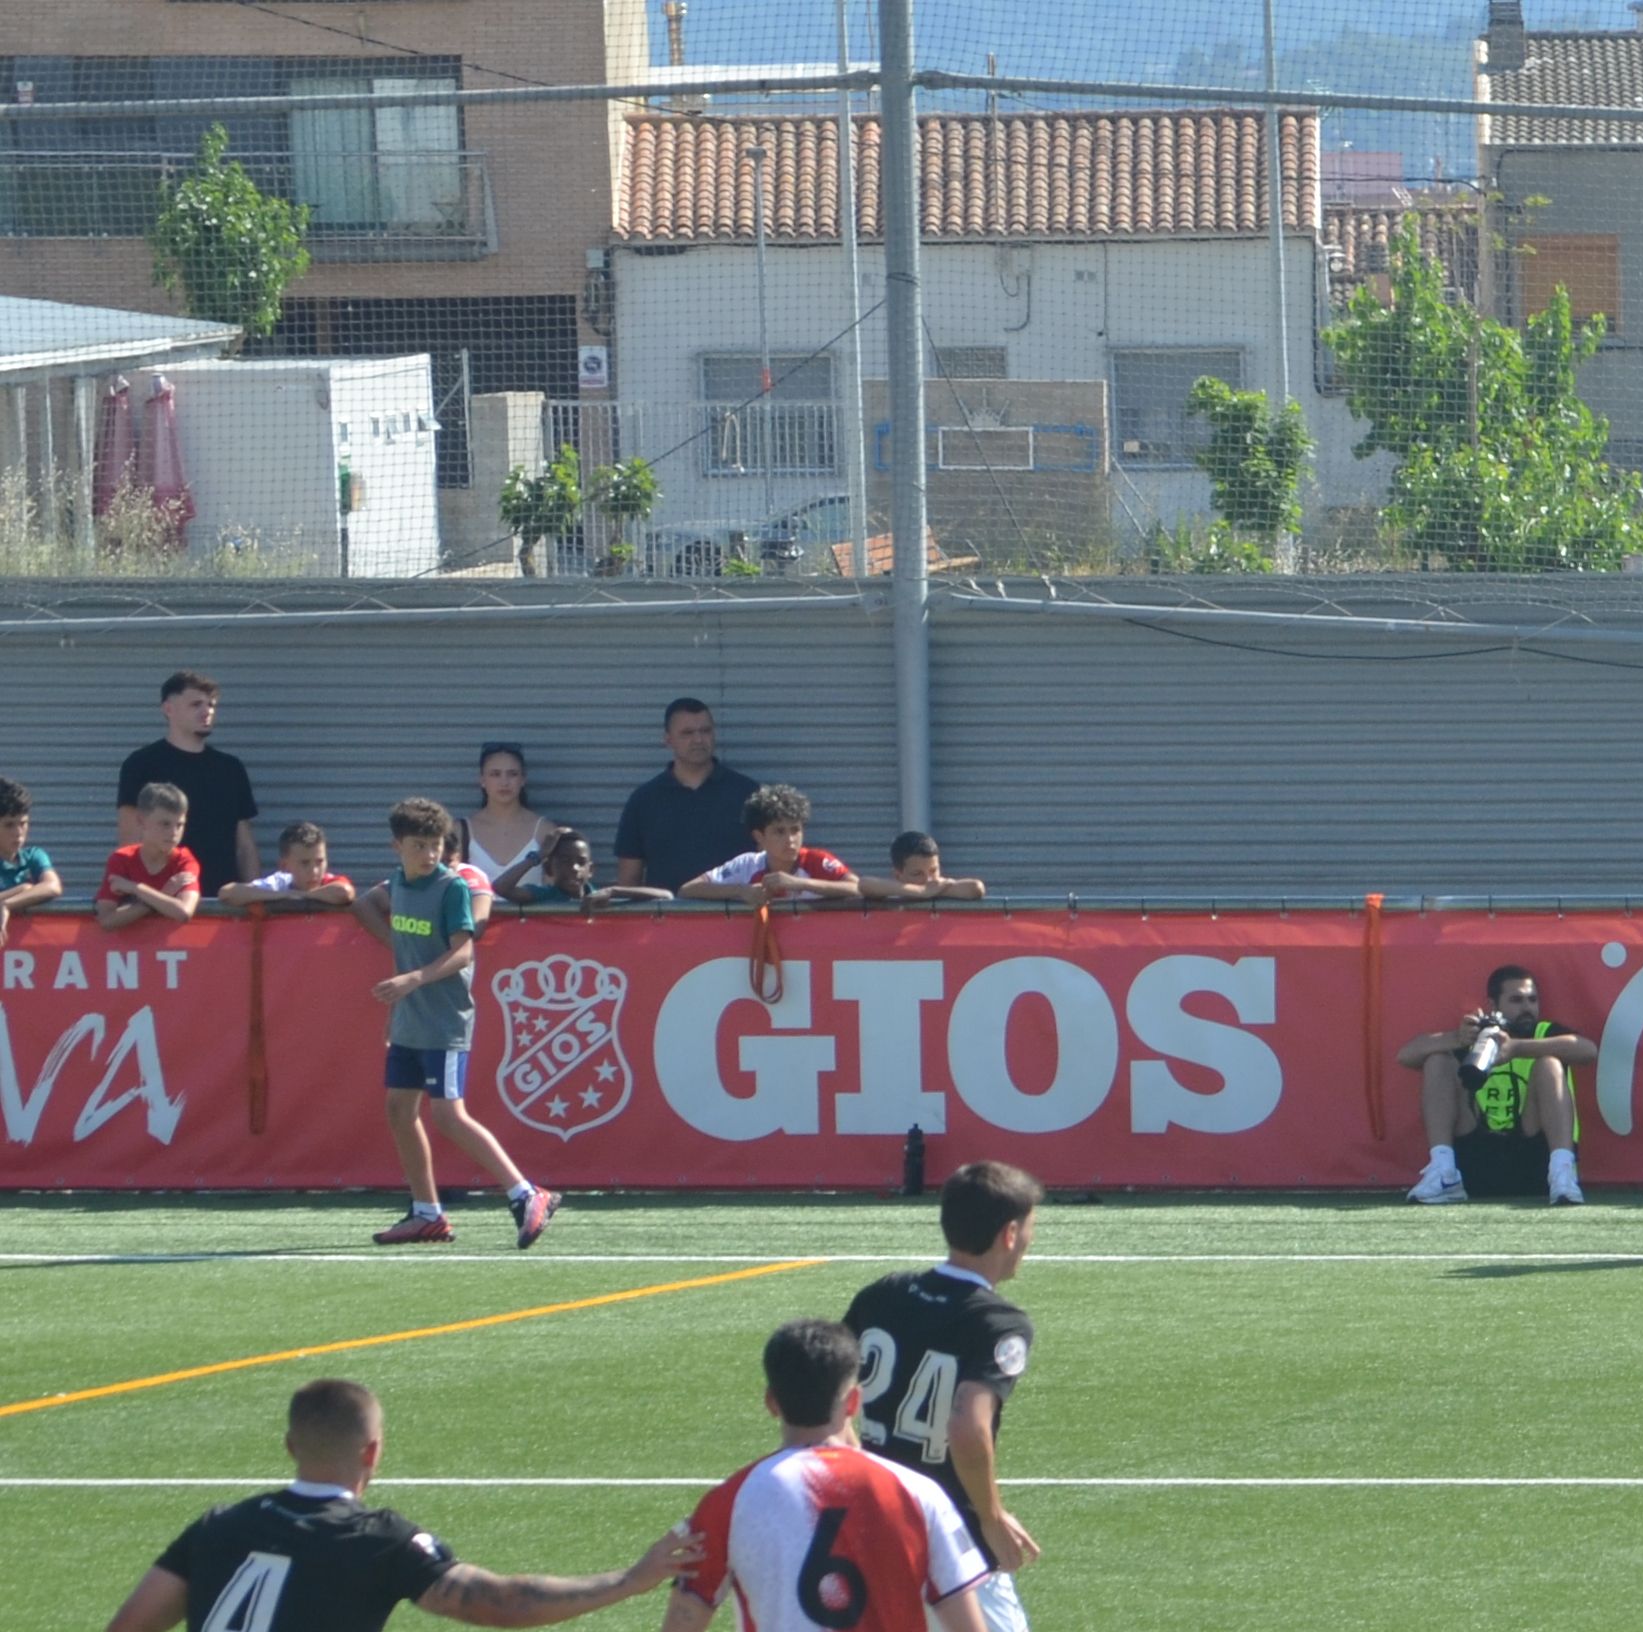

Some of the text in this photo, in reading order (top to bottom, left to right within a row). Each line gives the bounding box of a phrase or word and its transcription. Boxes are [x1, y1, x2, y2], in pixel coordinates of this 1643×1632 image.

[3, 950, 187, 990] RANT
[513, 1011, 608, 1093] GIOS
[654, 954, 1284, 1142] GIOS
[859, 1326, 959, 1464] 24
[797, 1506, 867, 1630] 6
